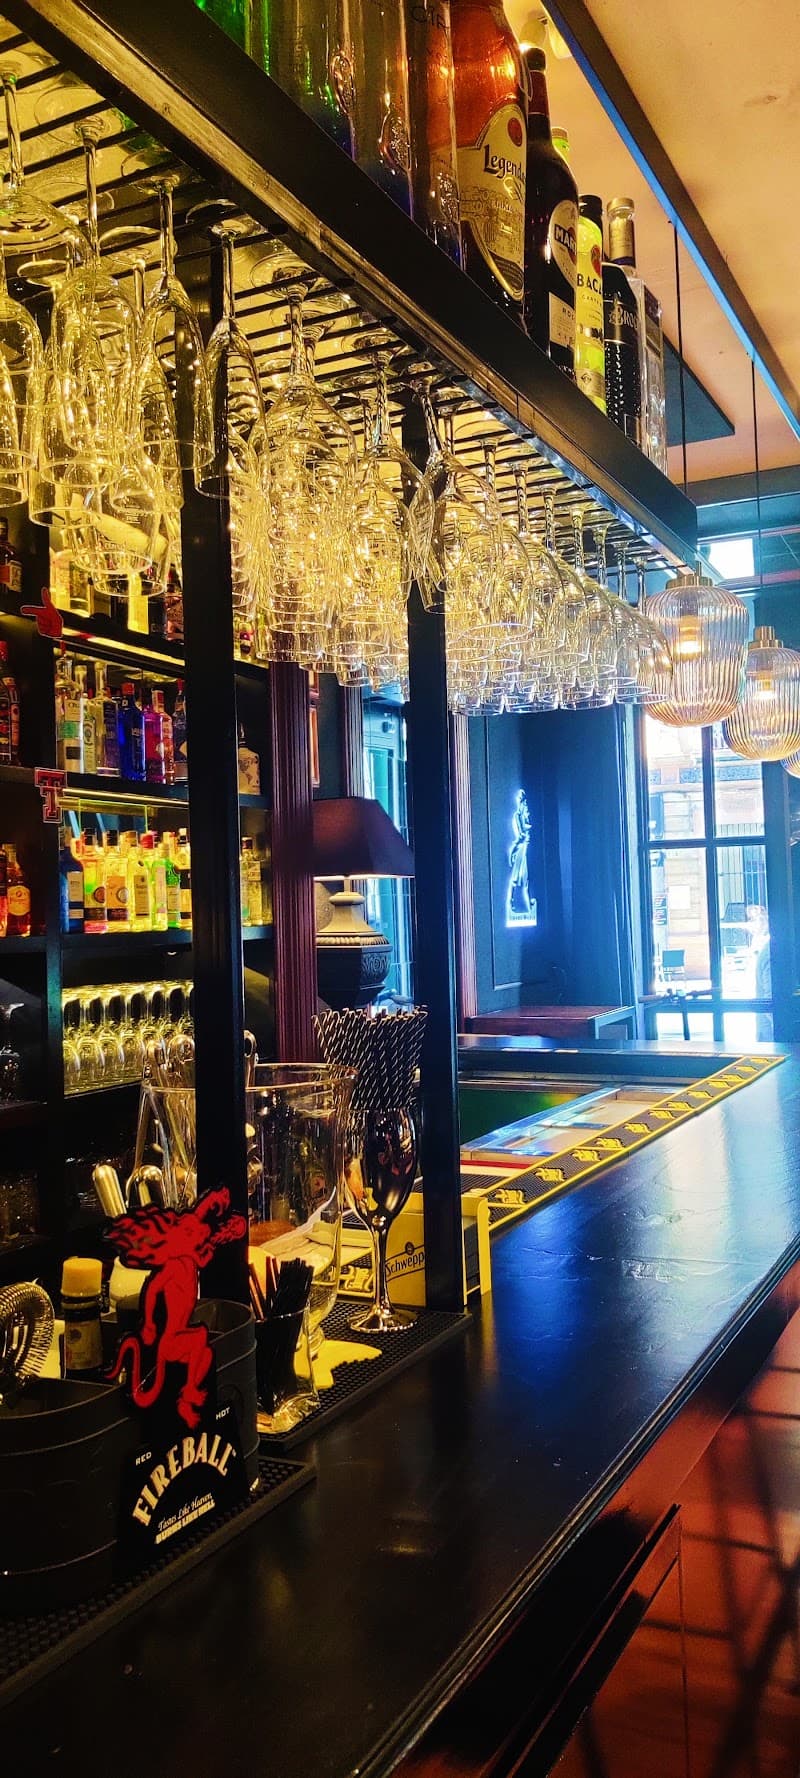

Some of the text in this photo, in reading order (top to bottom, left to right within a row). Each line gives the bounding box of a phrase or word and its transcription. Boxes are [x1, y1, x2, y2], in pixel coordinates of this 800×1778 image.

[215, 1406, 231, 1421] HOT
[135, 1451, 152, 1466] RED
[132, 1432, 233, 1526] FIREBALL
